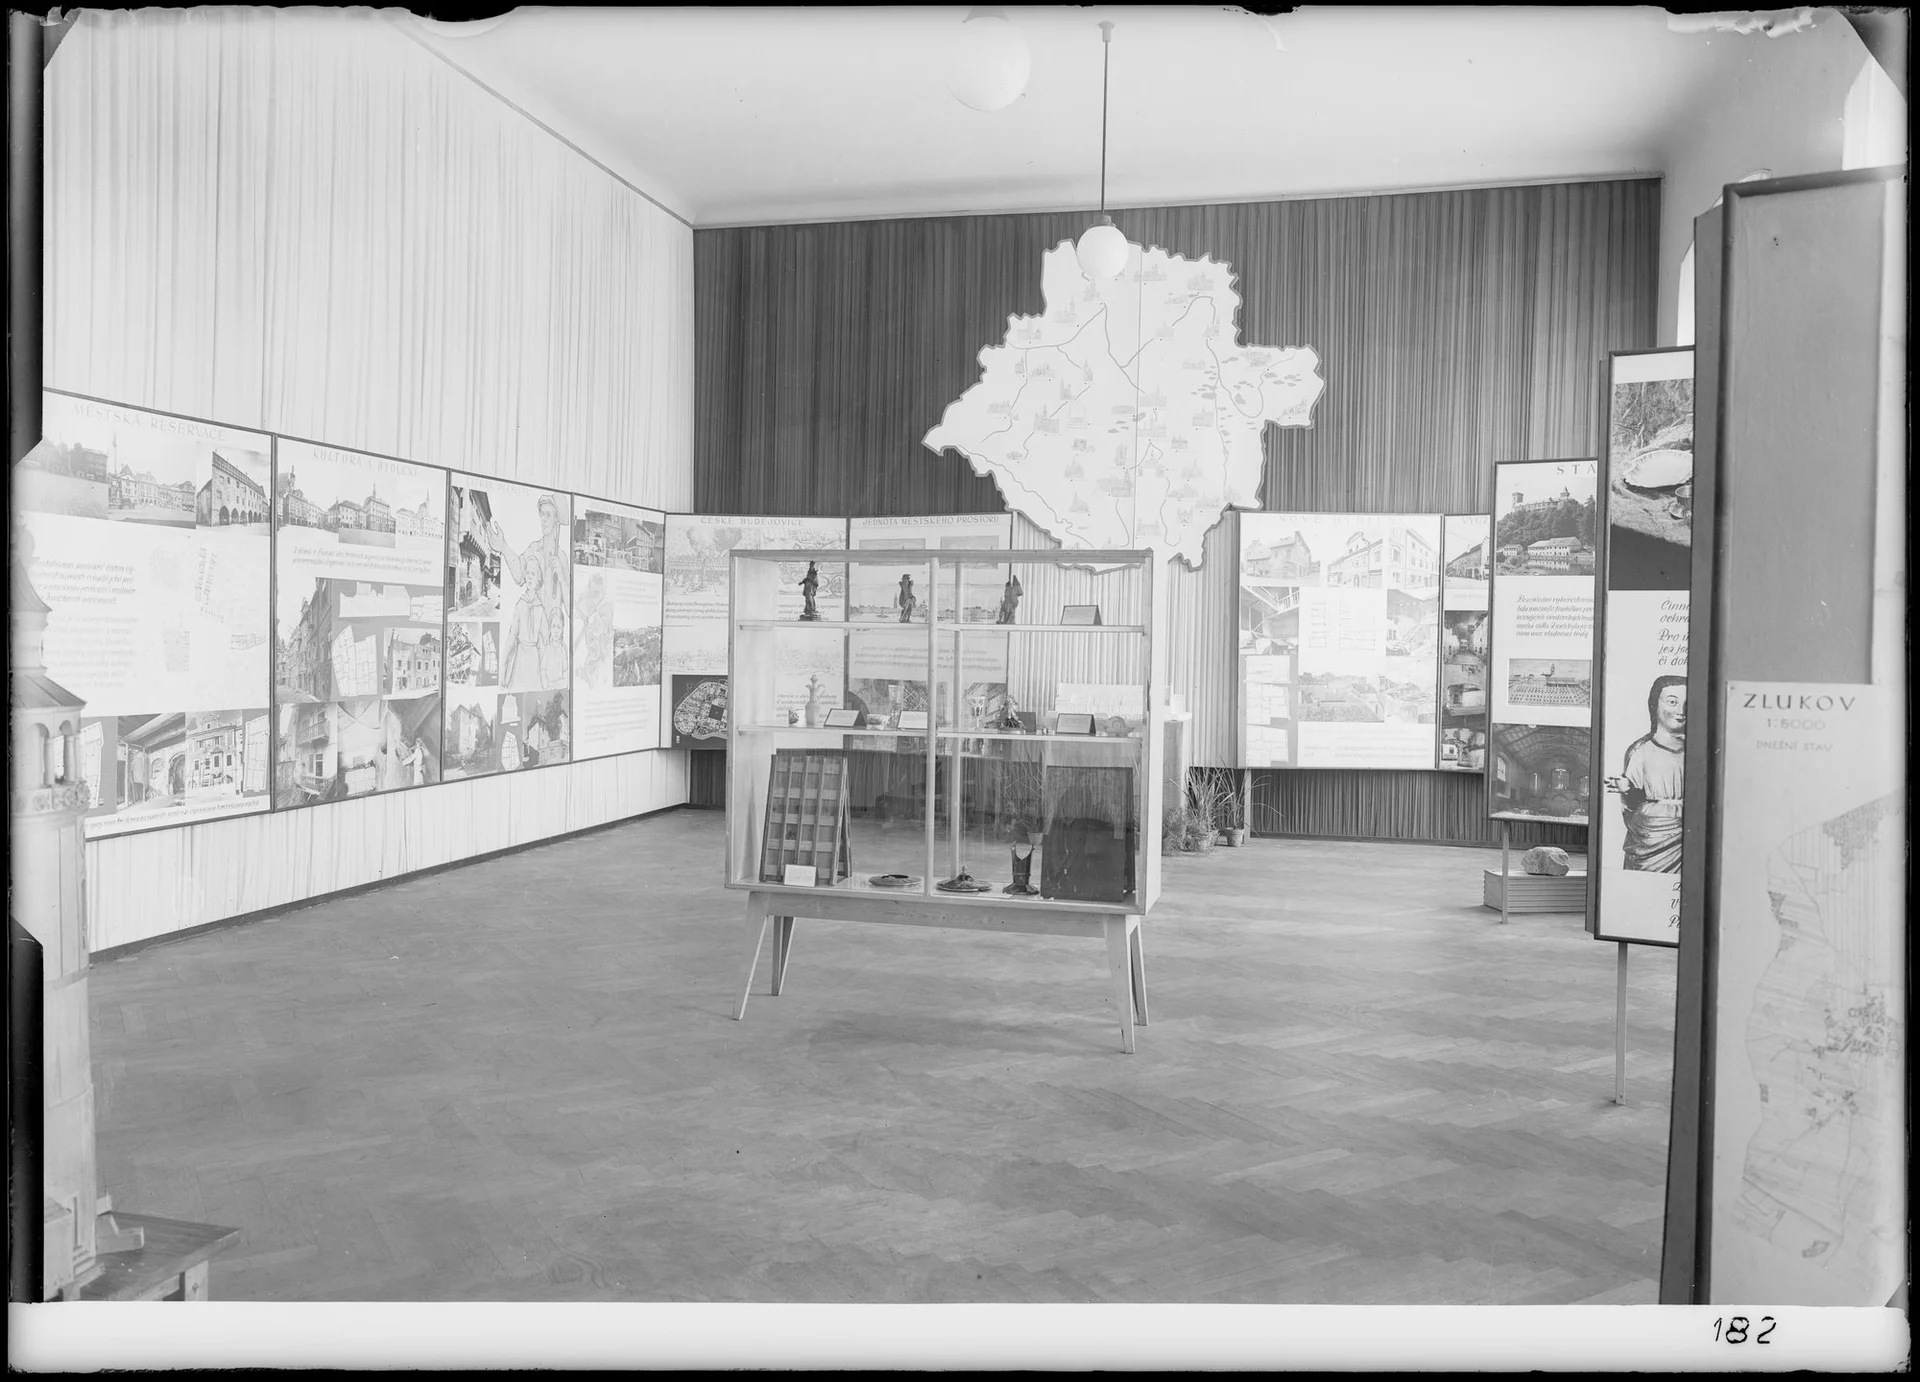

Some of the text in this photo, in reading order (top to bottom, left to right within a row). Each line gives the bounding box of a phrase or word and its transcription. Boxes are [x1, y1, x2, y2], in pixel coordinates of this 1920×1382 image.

[862, 518, 899, 527] JEDNOTA
[956, 515, 999, 525] PROSTORU
[1658, 628, 1680, 641] Pro
[1742, 692, 1857, 711] ZLUKOV
[1756, 739, 1833, 753] DNEŠNÍ STAV
[1713, 1316, 1777, 1345] 182
